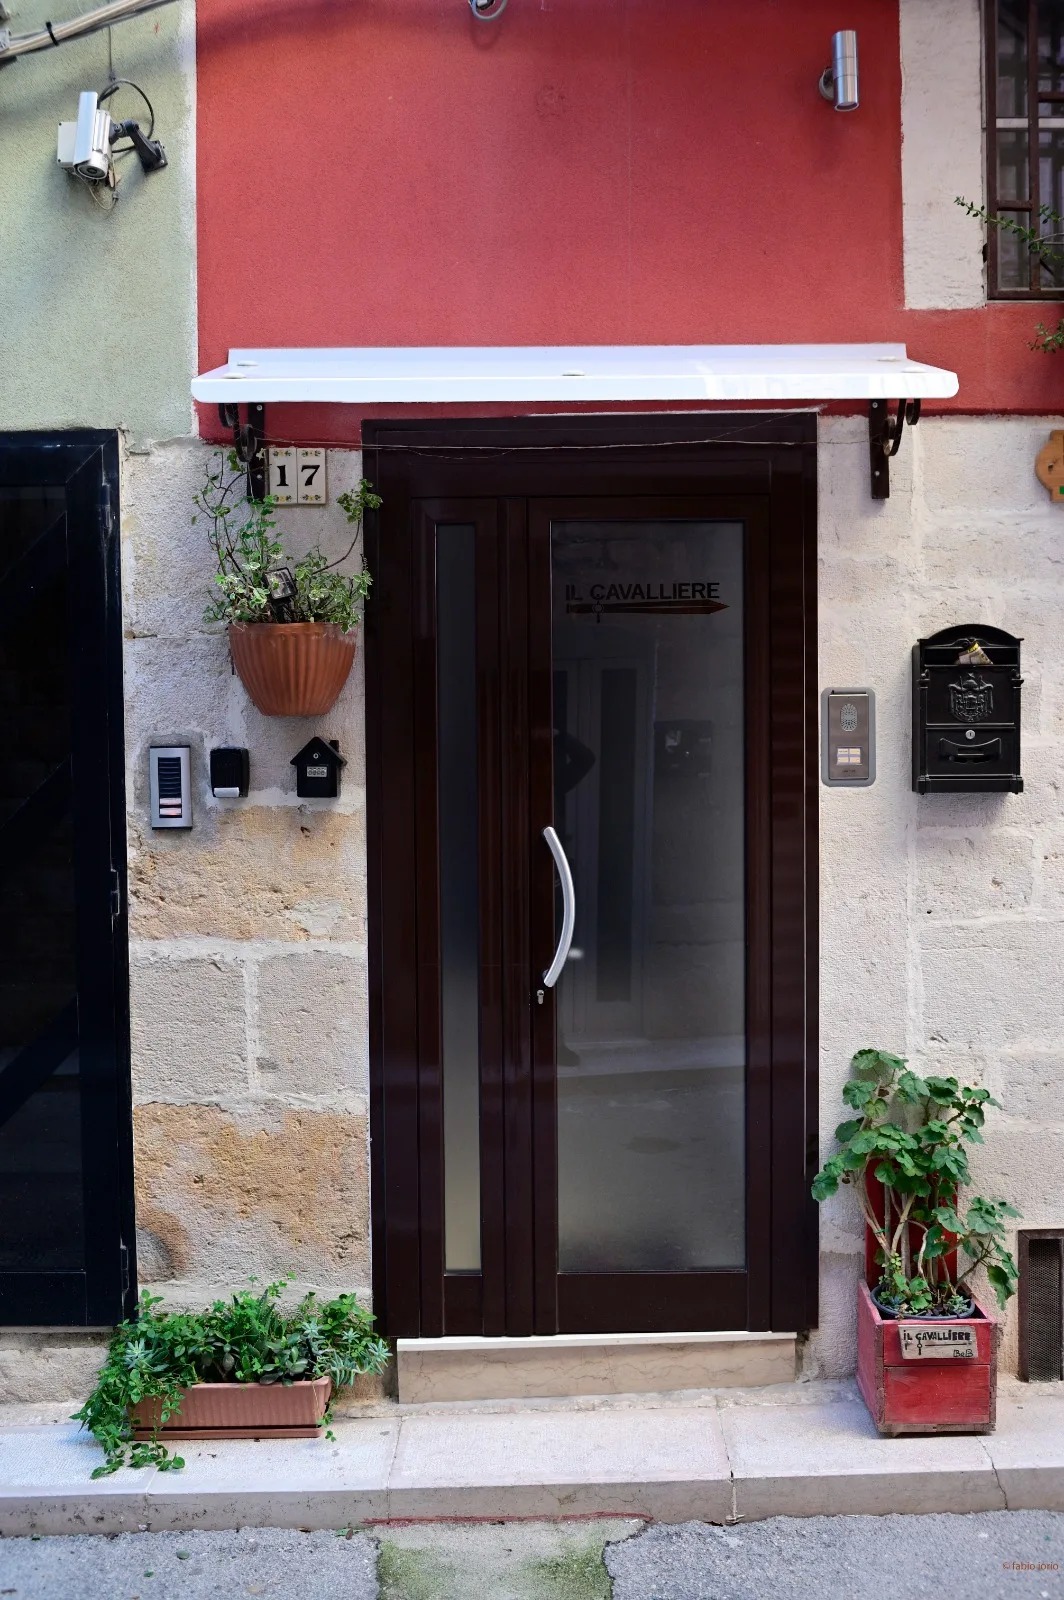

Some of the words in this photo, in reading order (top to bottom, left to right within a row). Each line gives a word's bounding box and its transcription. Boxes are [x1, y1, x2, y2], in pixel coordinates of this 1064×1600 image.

[276, 464, 320, 487] 17
[566, 584, 583, 600] IL
[590, 582, 720, 600] CAVALLIERE
